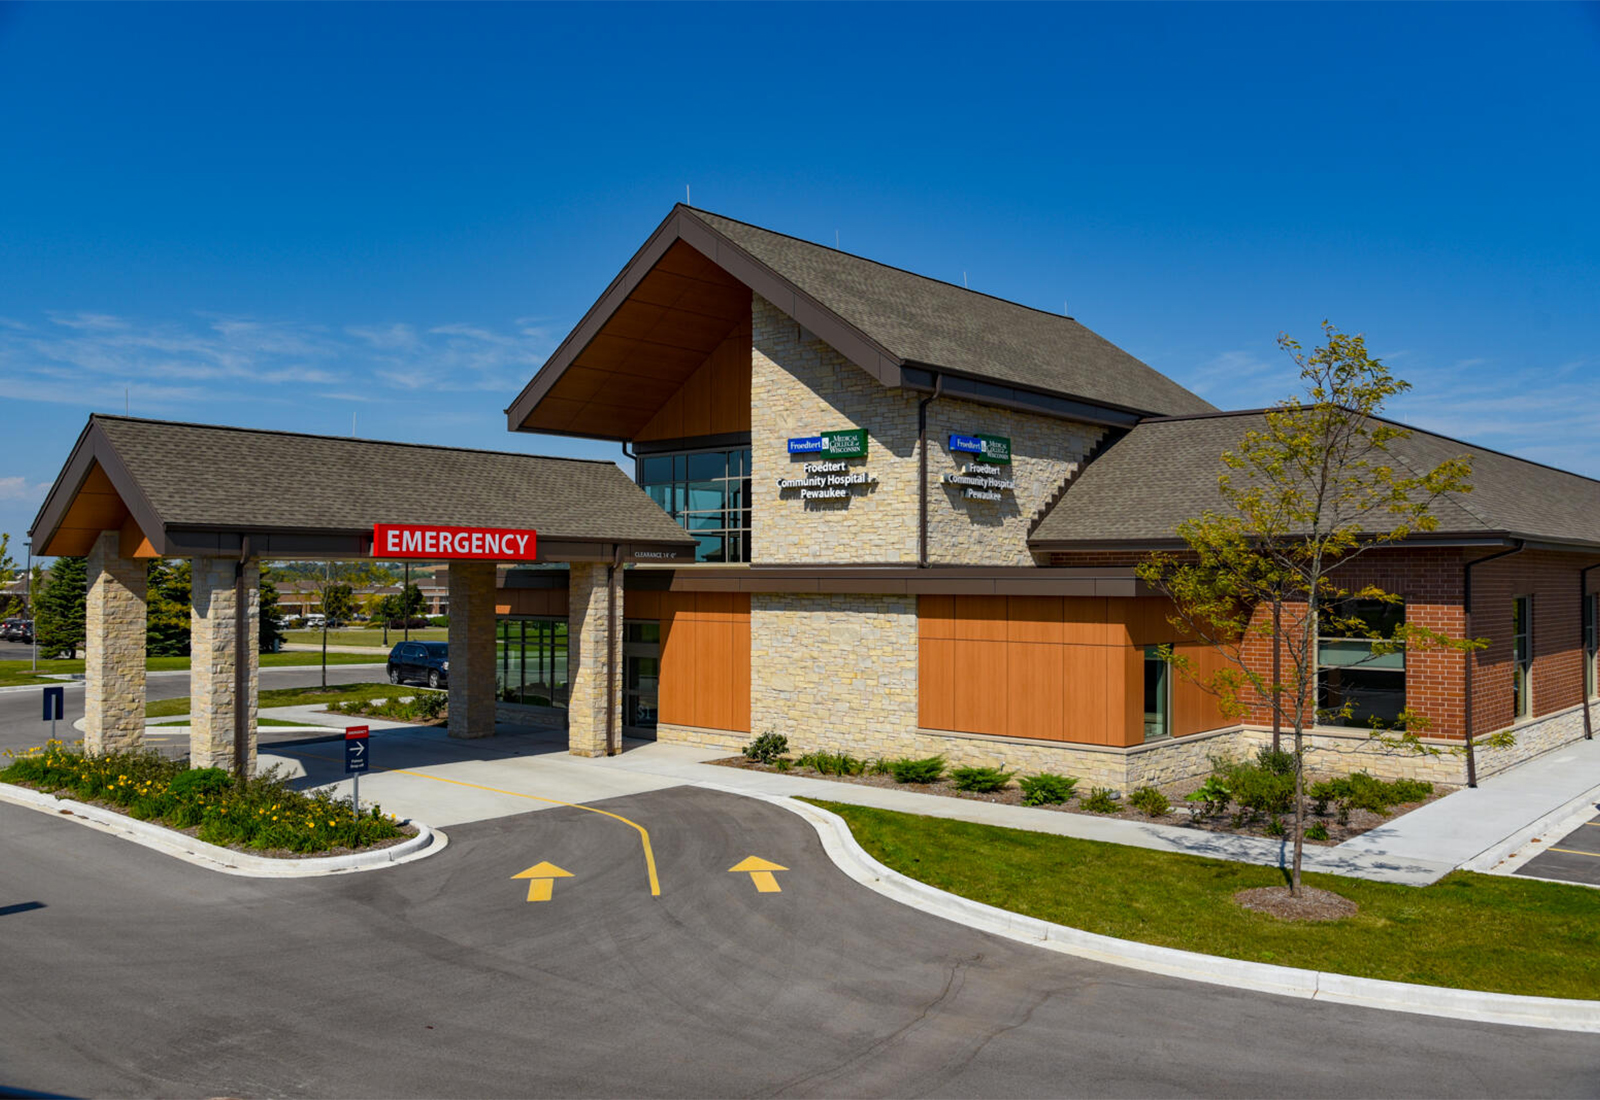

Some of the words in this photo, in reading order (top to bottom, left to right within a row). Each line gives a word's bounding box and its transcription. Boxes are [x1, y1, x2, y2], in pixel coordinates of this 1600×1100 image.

[790, 441, 821, 450] Froedtert
[957, 439, 980, 449] Froedtert
[803, 462, 846, 473] Froedtert
[969, 463, 1000, 475] Froedtert
[776, 475, 826, 488] Community
[827, 472, 866, 486] Hospital
[948, 474, 987, 489] Community
[988, 477, 1015, 490] Hospital
[801, 488, 846, 499] Pewaukee
[968, 488, 1001, 500] Pewaukee
[387, 530, 529, 555] EMERGENCY
